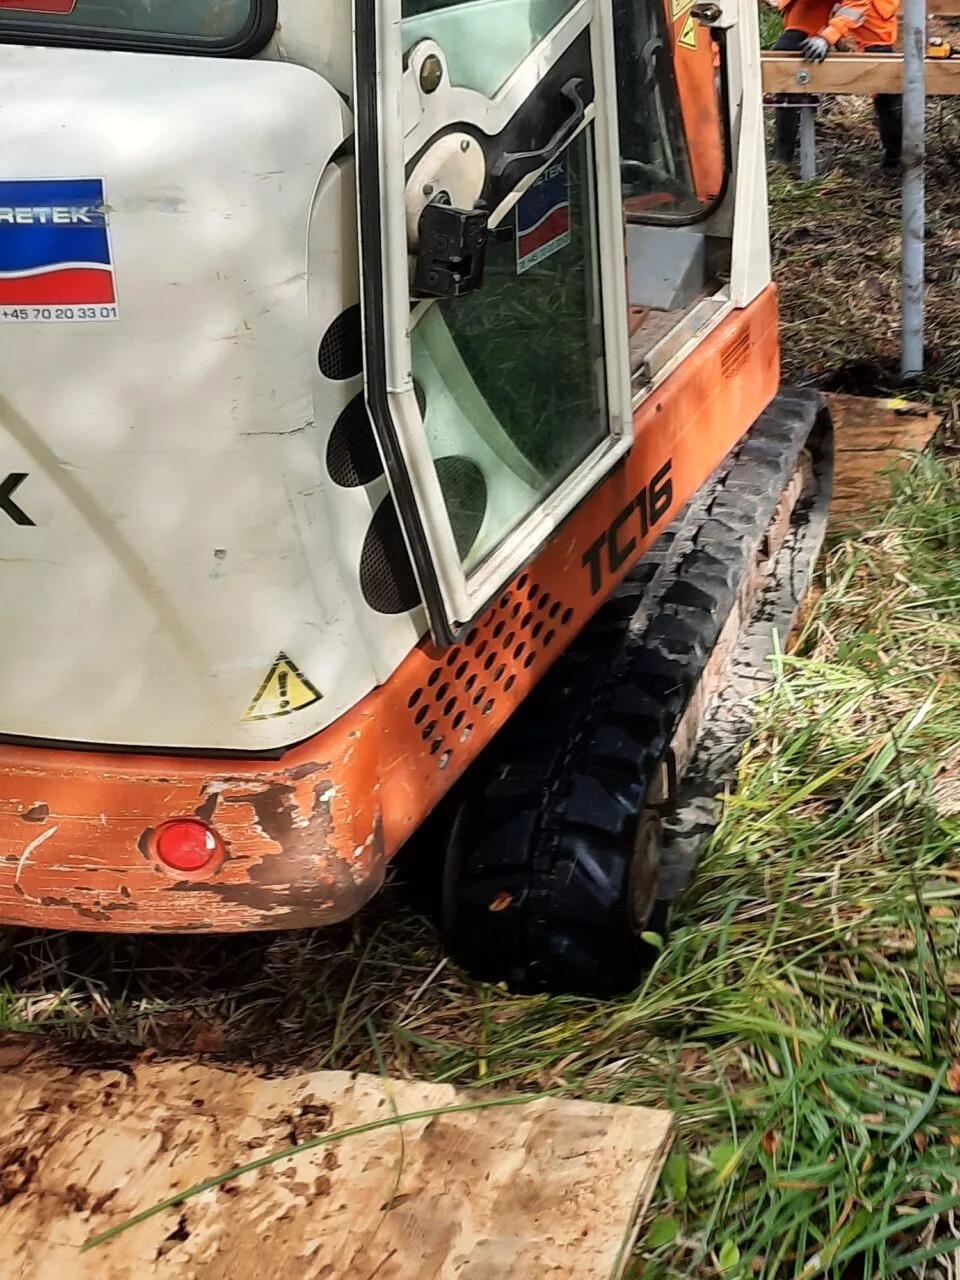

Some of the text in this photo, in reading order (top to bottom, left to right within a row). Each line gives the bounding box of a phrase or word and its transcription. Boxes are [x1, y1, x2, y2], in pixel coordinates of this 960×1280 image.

[2, 307, 117, 320] +45 70 20 33 01
[581, 457, 673, 596] TC16
